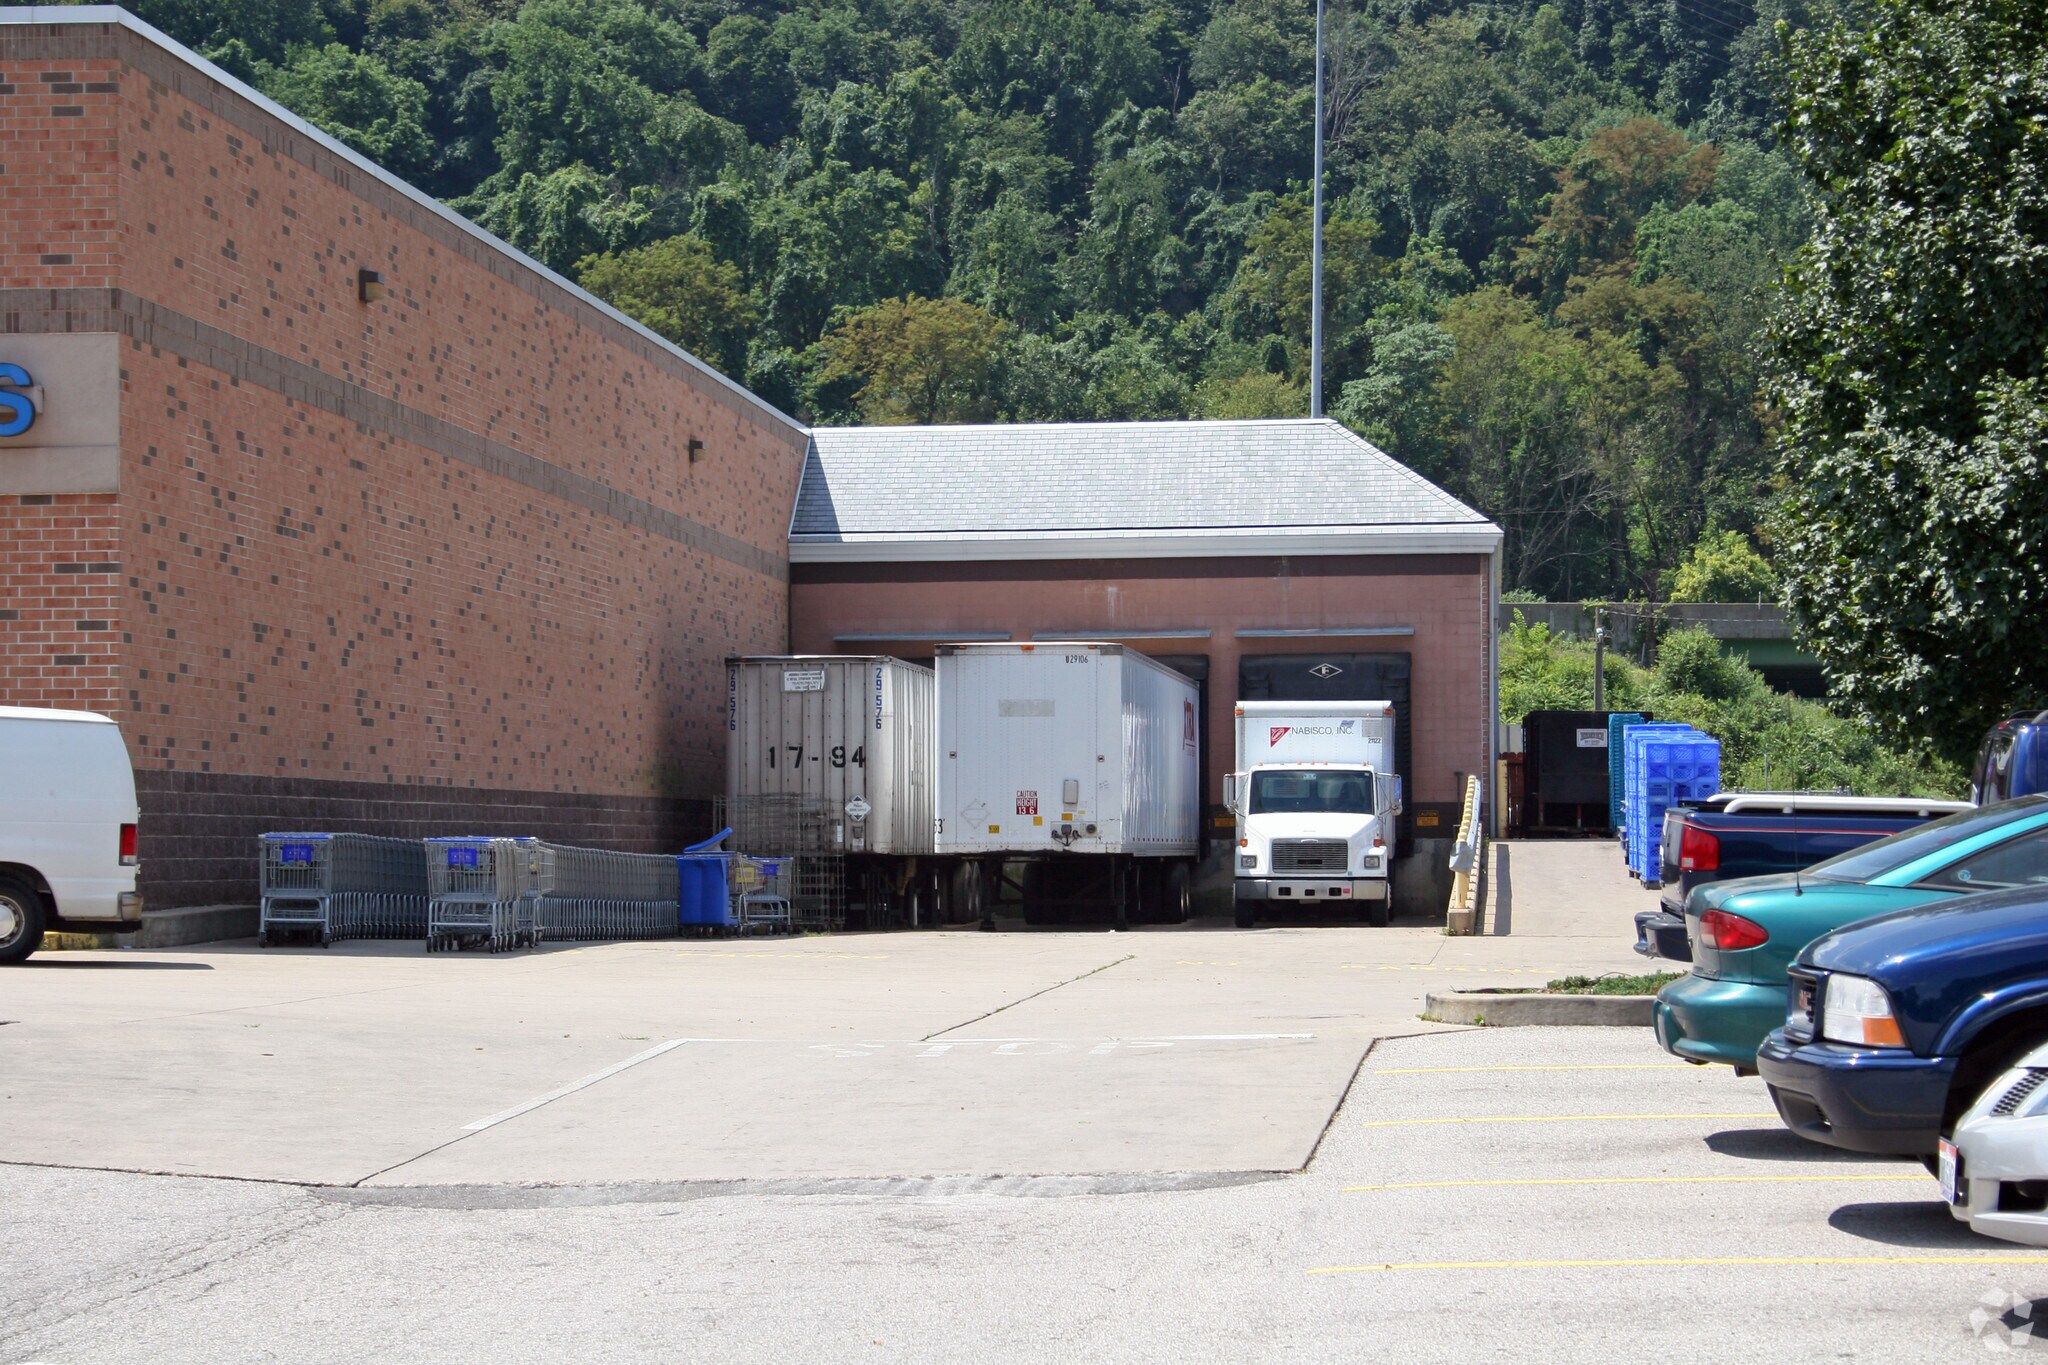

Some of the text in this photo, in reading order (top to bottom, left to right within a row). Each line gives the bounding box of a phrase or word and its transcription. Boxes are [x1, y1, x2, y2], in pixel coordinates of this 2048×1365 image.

[1291, 726, 1334, 736] NABISCO,
[1336, 726, 1354, 735] INC.
[769, 746, 866, 769] 17-94
[1016, 790, 1038, 798] CAUTION
[1016, 798, 1037, 807] HEIGHT
